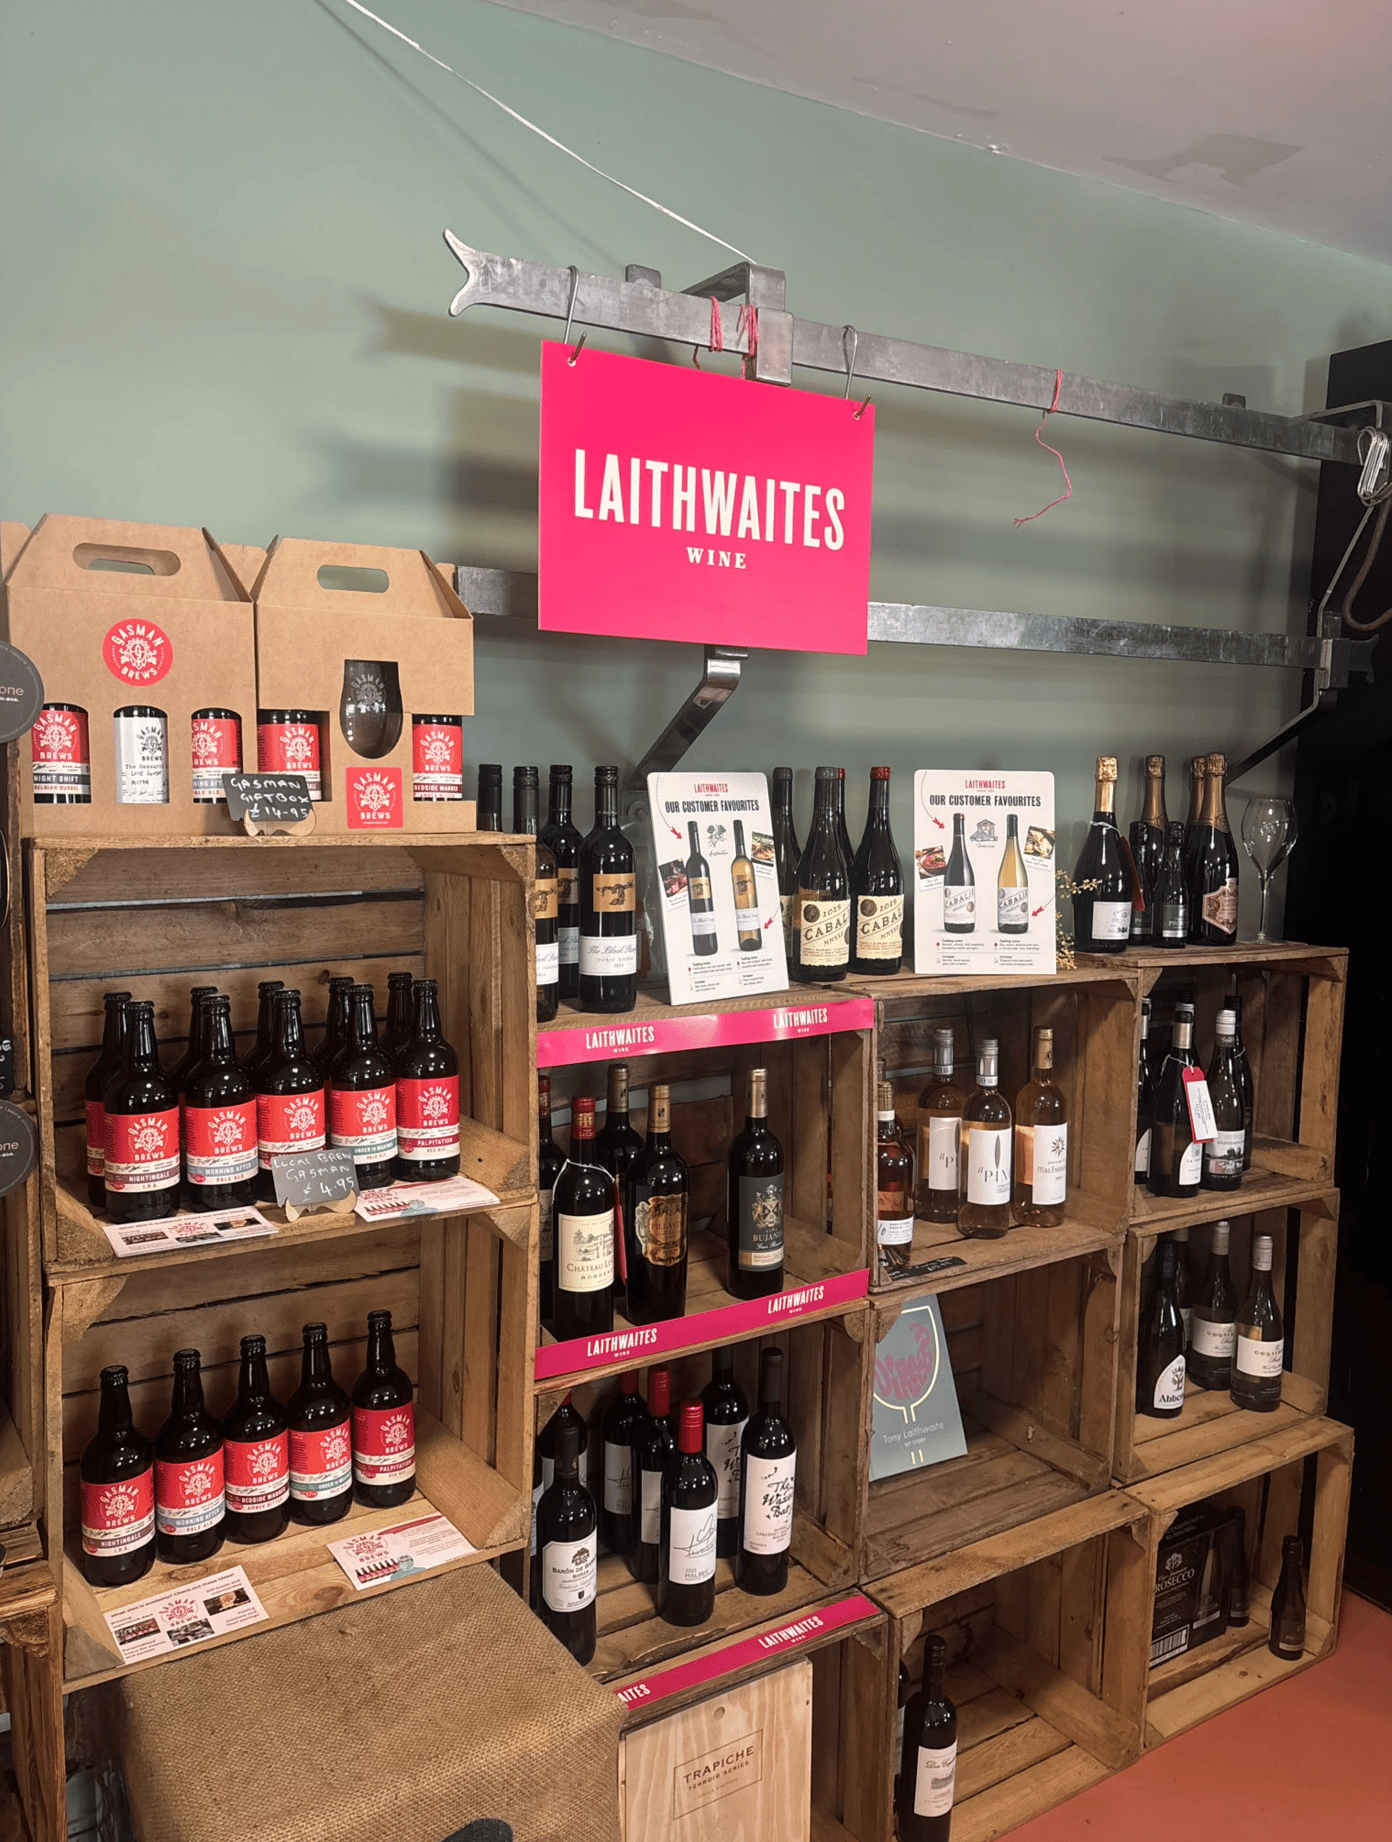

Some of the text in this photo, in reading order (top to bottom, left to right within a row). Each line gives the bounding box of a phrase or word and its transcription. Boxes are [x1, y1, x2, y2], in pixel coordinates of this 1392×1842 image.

[575, 448, 845, 551] LAITHWAITES
[686, 546, 747, 569] WINE
[111, 624, 164, 647] GASMAN
[121, 668, 158, 680] BREWS
[33, 713, 77, 732] GASMAN
[136, 726, 165, 740] GASMAN
[192, 721, 223, 739] SMAN
[280, 727, 314, 743] GASMAN
[420, 731, 455, 748] GASMAN
[40, 751, 73, 760] BREWS
[425, 764, 451, 772] BREWS
[59, 775, 78, 783] SHIFT
[230, 777, 301, 791] GASMAN
[353, 772, 396, 792] GASMAN
[965, 780, 1006, 789] LAITHWAITES
[694, 783, 729, 793] LAITHWAITES
[665, 799, 760, 813] OUR CUSTOMER FAVOURITES
[929, 794, 1042, 807] OUR CUSTOMER FAVOURITES
[360, 812, 391, 820] BREWS
[773, 1007, 828, 1029] LAITHWAITES
[586, 1026, 655, 1049] LAITHWAITES
[356, 1091, 391, 1110] GASMAN
[418, 1086, 452, 1102] GASMAN
[284, 1096, 320, 1115] GASMAN
[128, 1116, 168, 1136] GASMAN
[207, 1110, 247, 1129] GASMAN
[423, 1118, 449, 1127] BREWS
[289, 1129, 316, 1140] BREWS
[362, 1124, 388, 1134] BREWS
[214, 1144, 243, 1154] BREWS
[417, 1137, 453, 1147] PALPITATION
[134, 1151, 164, 1161] BREWS
[354, 1146, 371, 1154] UNDER
[205, 1162, 252, 1175] MORNING AFTER
[274, 1157, 311, 1168] LOCAL
[128, 1171, 170, 1182] NIGHTINGALE
[285, 1165, 350, 1182] GASMAN
[767, 1285, 824, 1314] LAITHWAITES
[587, 1327, 658, 1357] LAITHWAITES
[614, 1349, 630, 1358] WINE
[380, 1413, 411, 1432] GASMAN
[320, 1428, 349, 1448] GASMAN
[883, 1422, 945, 1445] Tony Laithwaite
[385, 1442, 408, 1454] BREWS
[914, 1437, 926, 1446] STORY
[247, 1442, 282, 1461] GASMAN
[325, 1456, 348, 1470] BREWS
[379, 1459, 412, 1472] PALPITATION
[179, 1463, 216, 1483] GASMAN
[252, 1471, 279, 1484] BREWS
[318, 1481, 334, 1490] UNDER
[767, 1477, 790, 1493] The
[100, 1484, 140, 1504] GASMAN
[185, 1492, 212, 1506] BREWS
[241, 1495, 267, 1504] BEDSIDE
[105, 1514, 136, 1528] BREWS
[175, 1508, 220, 1526] MORNING AFTER
[203, 1520, 213, 1528] ALE
[101, 1533, 141, 1547] NIGHTINGALE
[343, 1535, 384, 1550] GASMAN
[359, 1550, 390, 1563] BREWS
[1155, 1568, 1195, 1592] ROSECCO
[158, 1598, 197, 1616] GASMAN
[170, 1615, 199, 1627] BREWS
[758, 1615, 824, 1650] LAITHWAITES
[683, 1745, 754, 1784] TRAPICHE
[688, 1760, 749, 1791] TERROIR SERIES
